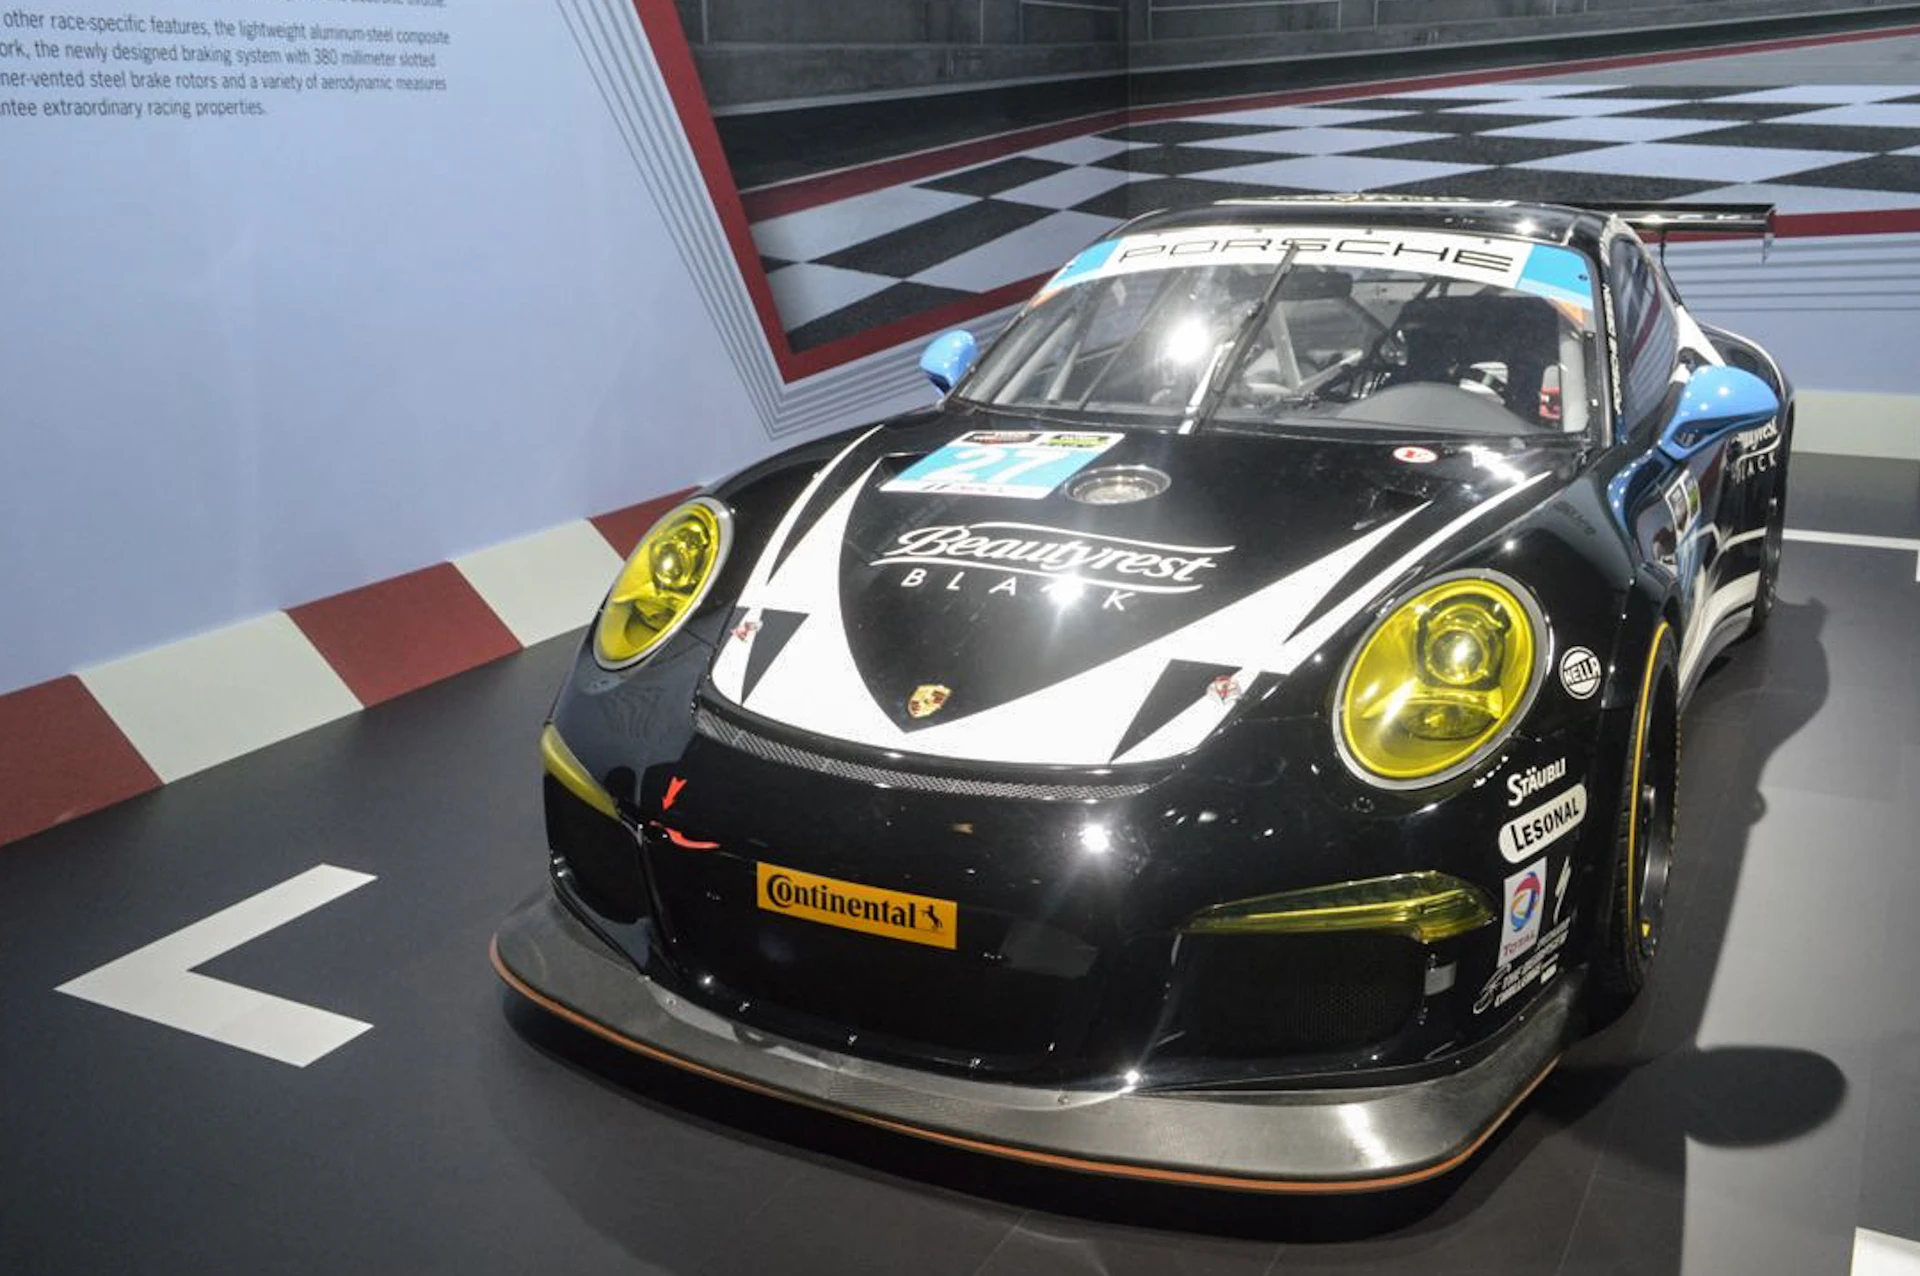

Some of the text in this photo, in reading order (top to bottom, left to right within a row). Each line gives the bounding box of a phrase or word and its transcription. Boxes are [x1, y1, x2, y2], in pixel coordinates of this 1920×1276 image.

[3, 10, 450, 44] other race-specific features, the lightweight aluminum-steel composite
[35, 39, 60, 58] the
[65, 43, 108, 63] newly
[112, 43, 178, 65] designed
[182, 46, 233, 66] braking
[235, 49, 282, 66] system
[286, 48, 310, 64] with
[314, 48, 338, 65] 380
[90, 70, 126, 88] steel
[131, 71, 172, 88] brake
[176, 73, 218, 89] rotors
[221, 73, 246, 89] and
[250, 76, 259, 89] a
[262, 74, 303, 92] variety
[306, 73, 318, 89] of
[321, 74, 393, 92] aerodynamic
[396, 78, 447, 91] measures
[43, 99, 143, 119] extraordinary
[148, 100, 192, 118] racing
[195, 99, 267, 117] properties.
[1119, 236, 1514, 273] PORSCHE
[921, 447, 1071, 484] 27
[884, 524, 1217, 582] Beautyrest
[901, 567, 1135, 611] BLAK
[1506, 757, 1567, 807] STÄUBLI
[1510, 797, 1581, 852] LESONAL
[766, 873, 916, 929] Continental
